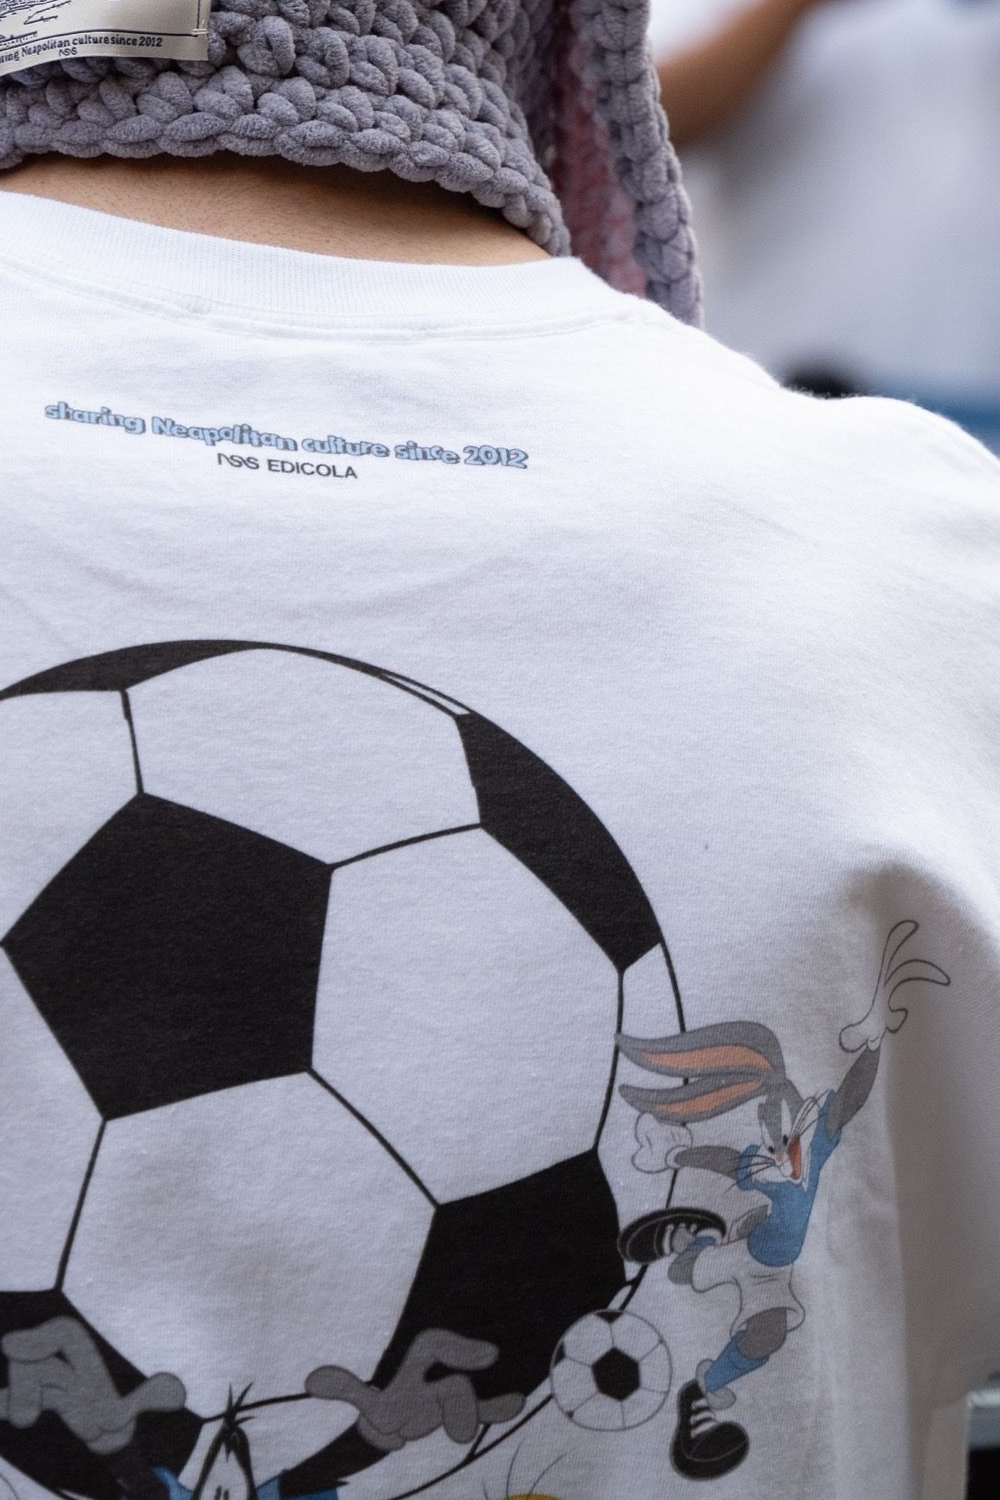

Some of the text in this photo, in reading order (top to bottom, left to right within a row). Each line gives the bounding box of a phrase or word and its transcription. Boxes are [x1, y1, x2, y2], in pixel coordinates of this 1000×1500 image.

[21, 37, 70, 57] Neapolitan
[72, 35, 109, 47] culture
[109, 36, 138, 47] since
[139, 37, 163, 47] 2012
[44, 401, 530, 470] sharing Neapolitan culture since 2012
[266, 458, 358, 479] EDICOLA
